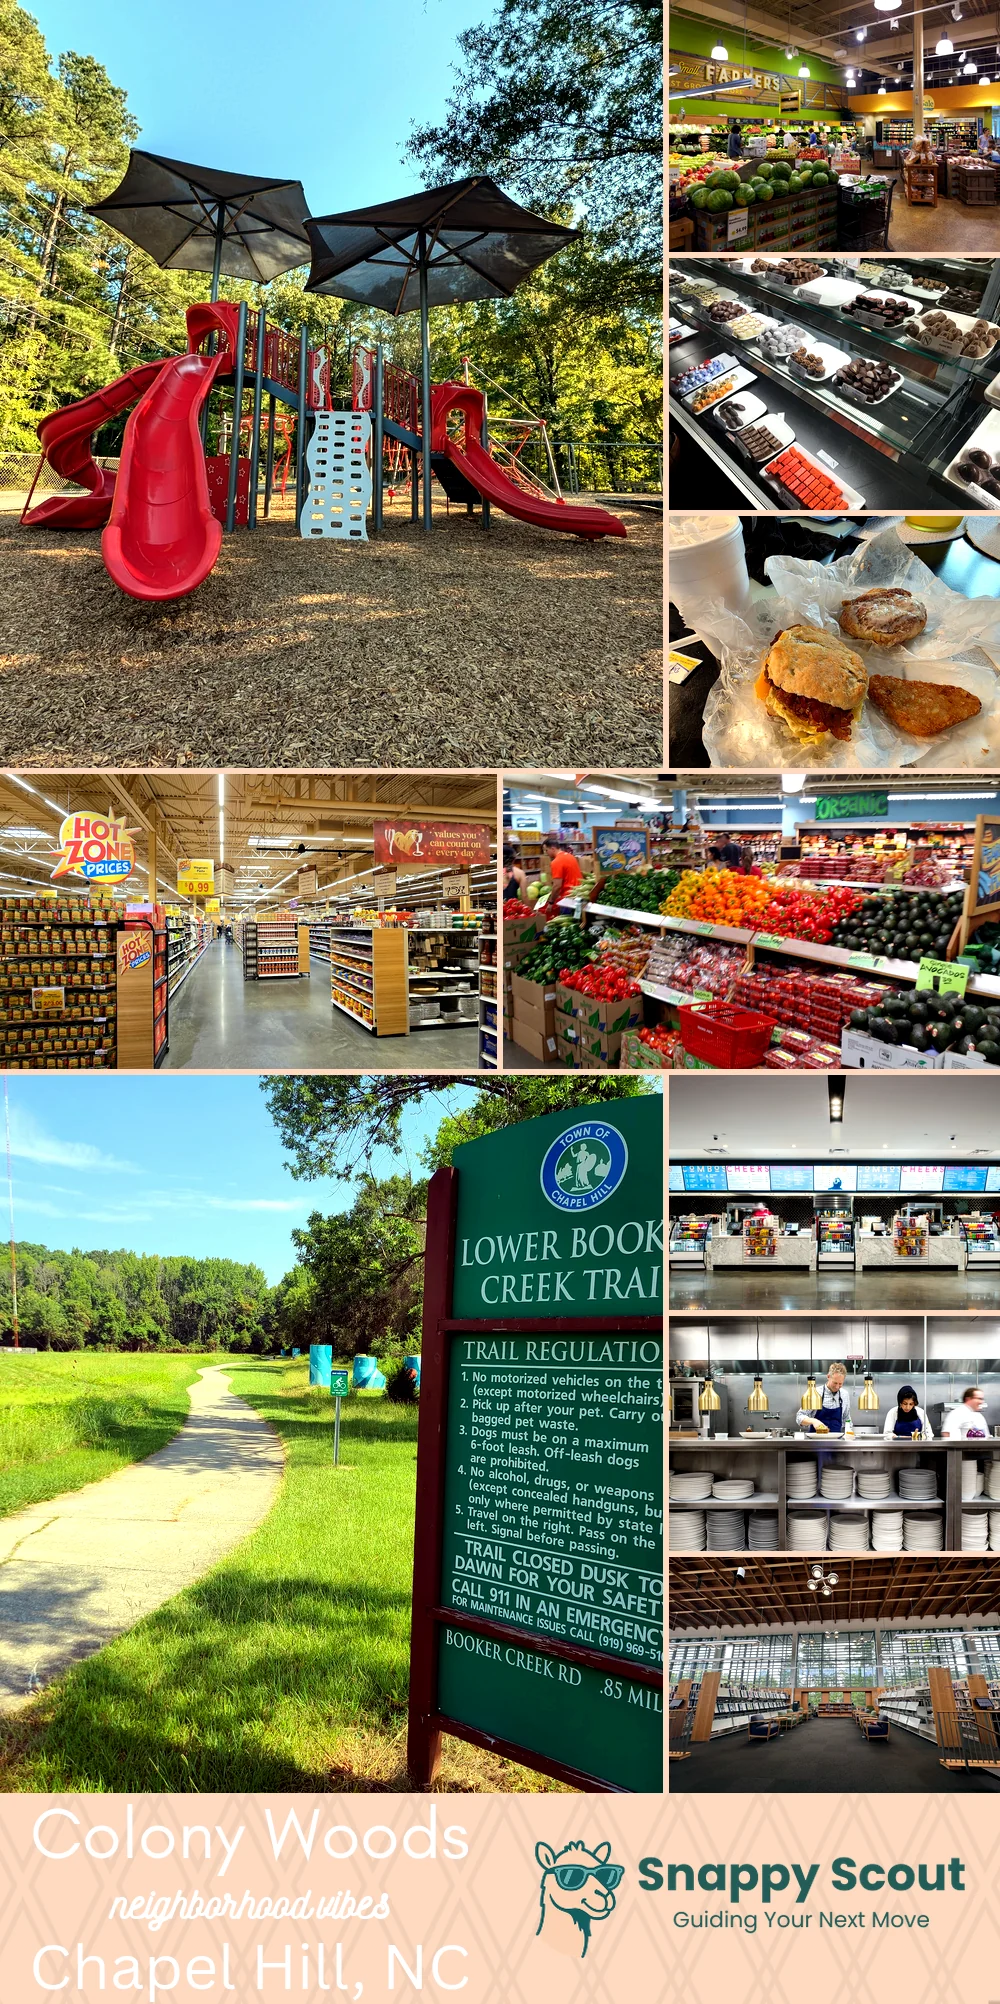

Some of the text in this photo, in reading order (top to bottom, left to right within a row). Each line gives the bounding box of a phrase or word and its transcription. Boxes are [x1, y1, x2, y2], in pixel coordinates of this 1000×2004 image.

[679, 62, 700, 75] Small
[74, 817, 121, 841] HOT
[434, 830, 460, 838] values
[65, 840, 131, 864] ZONE
[436, 849, 476, 859] every day
[86, 862, 130, 876] PRICES
[184, 882, 208, 892] $0.99
[122, 937, 141, 954] HOT
[122, 945, 149, 966] ZONE
[130, 952, 150, 968] PRICES
[920, 964, 965, 978] AVOCADOS
[560, 1126, 610, 1147] TOWN OF
[551, 1184, 612, 1207] CHAPEL HILL
[461, 1230, 562, 1266] LOWER
[480, 1265, 660, 1304] CREEK TRAI
[463, 1341, 663, 1363] TRAIL REGULATIO
[462, 1372, 468, 1382] 1.
[472, 1372, 486, 1382] No
[491, 1372, 548, 1384] motorized
[552, 1374, 600, 1386] vehicles
[604, 1378, 622, 1388] on
[628, 1376, 650, 1389] the
[474, 1384, 512, 1400] (except
[516, 1388, 576, 1400] motorized
[460, 1398, 468, 1408] 2.
[472, 1398, 492, 1410] Pick
[496, 1402, 510, 1413] up
[514, 1402, 542, 1413] after
[547, 1406, 574, 1417] your
[579, 1407, 604, 1420] pet.
[610, 1408, 646, 1424] Carry
[472, 1412, 578, 1431] bagged pet waste.
[459, 1425, 648, 1453] 3. Dogs must be on a maximum
[470, 1440, 640, 1470] 6-foot leash. Off-leash dogs
[470, 1455, 549, 1472] are prohibited.
[458, 1465, 655, 1502] 4. No alcohol, drugs, or weapons
[469, 1478, 508, 1496] (except
[512, 1488, 568, 1504] concealed
[572, 1494, 638, 1516] handguns,
[468, 1494, 490, 1508] only
[494, 1498, 528, 1512] where
[533, 1506, 592, 1522] permitted
[597, 1513, 614, 1528] by
[618, 1518, 654, 1533] state
[456, 1504, 656, 1550] 5. Travel on the right. Pass on the
[467, 1519, 619, 1560] left. Signal before passing.
[464, 1540, 663, 1596] TRAIL CLOSED DUSK TO
[454, 1554, 663, 1616] DAWN FOR YOUR SAFET
[452, 1578, 484, 1600] CALL
[490, 1587, 510, 1606] 911
[516, 1594, 530, 1612] IN
[536, 1600, 560, 1619] AN
[452, 1594, 468, 1608] FOR
[470, 1600, 534, 1624] MAINTENANCE
[536, 1618, 566, 1634] ISSUES
[570, 1627, 594, 1642] CALL
[599, 1633, 624, 1652] (919)
[446, 1629, 502, 1662] BOOKER
[505, 1648, 554, 1678] CREEK
[558, 1663, 582, 1686] RD
[600, 1678, 623, 1700] .85
